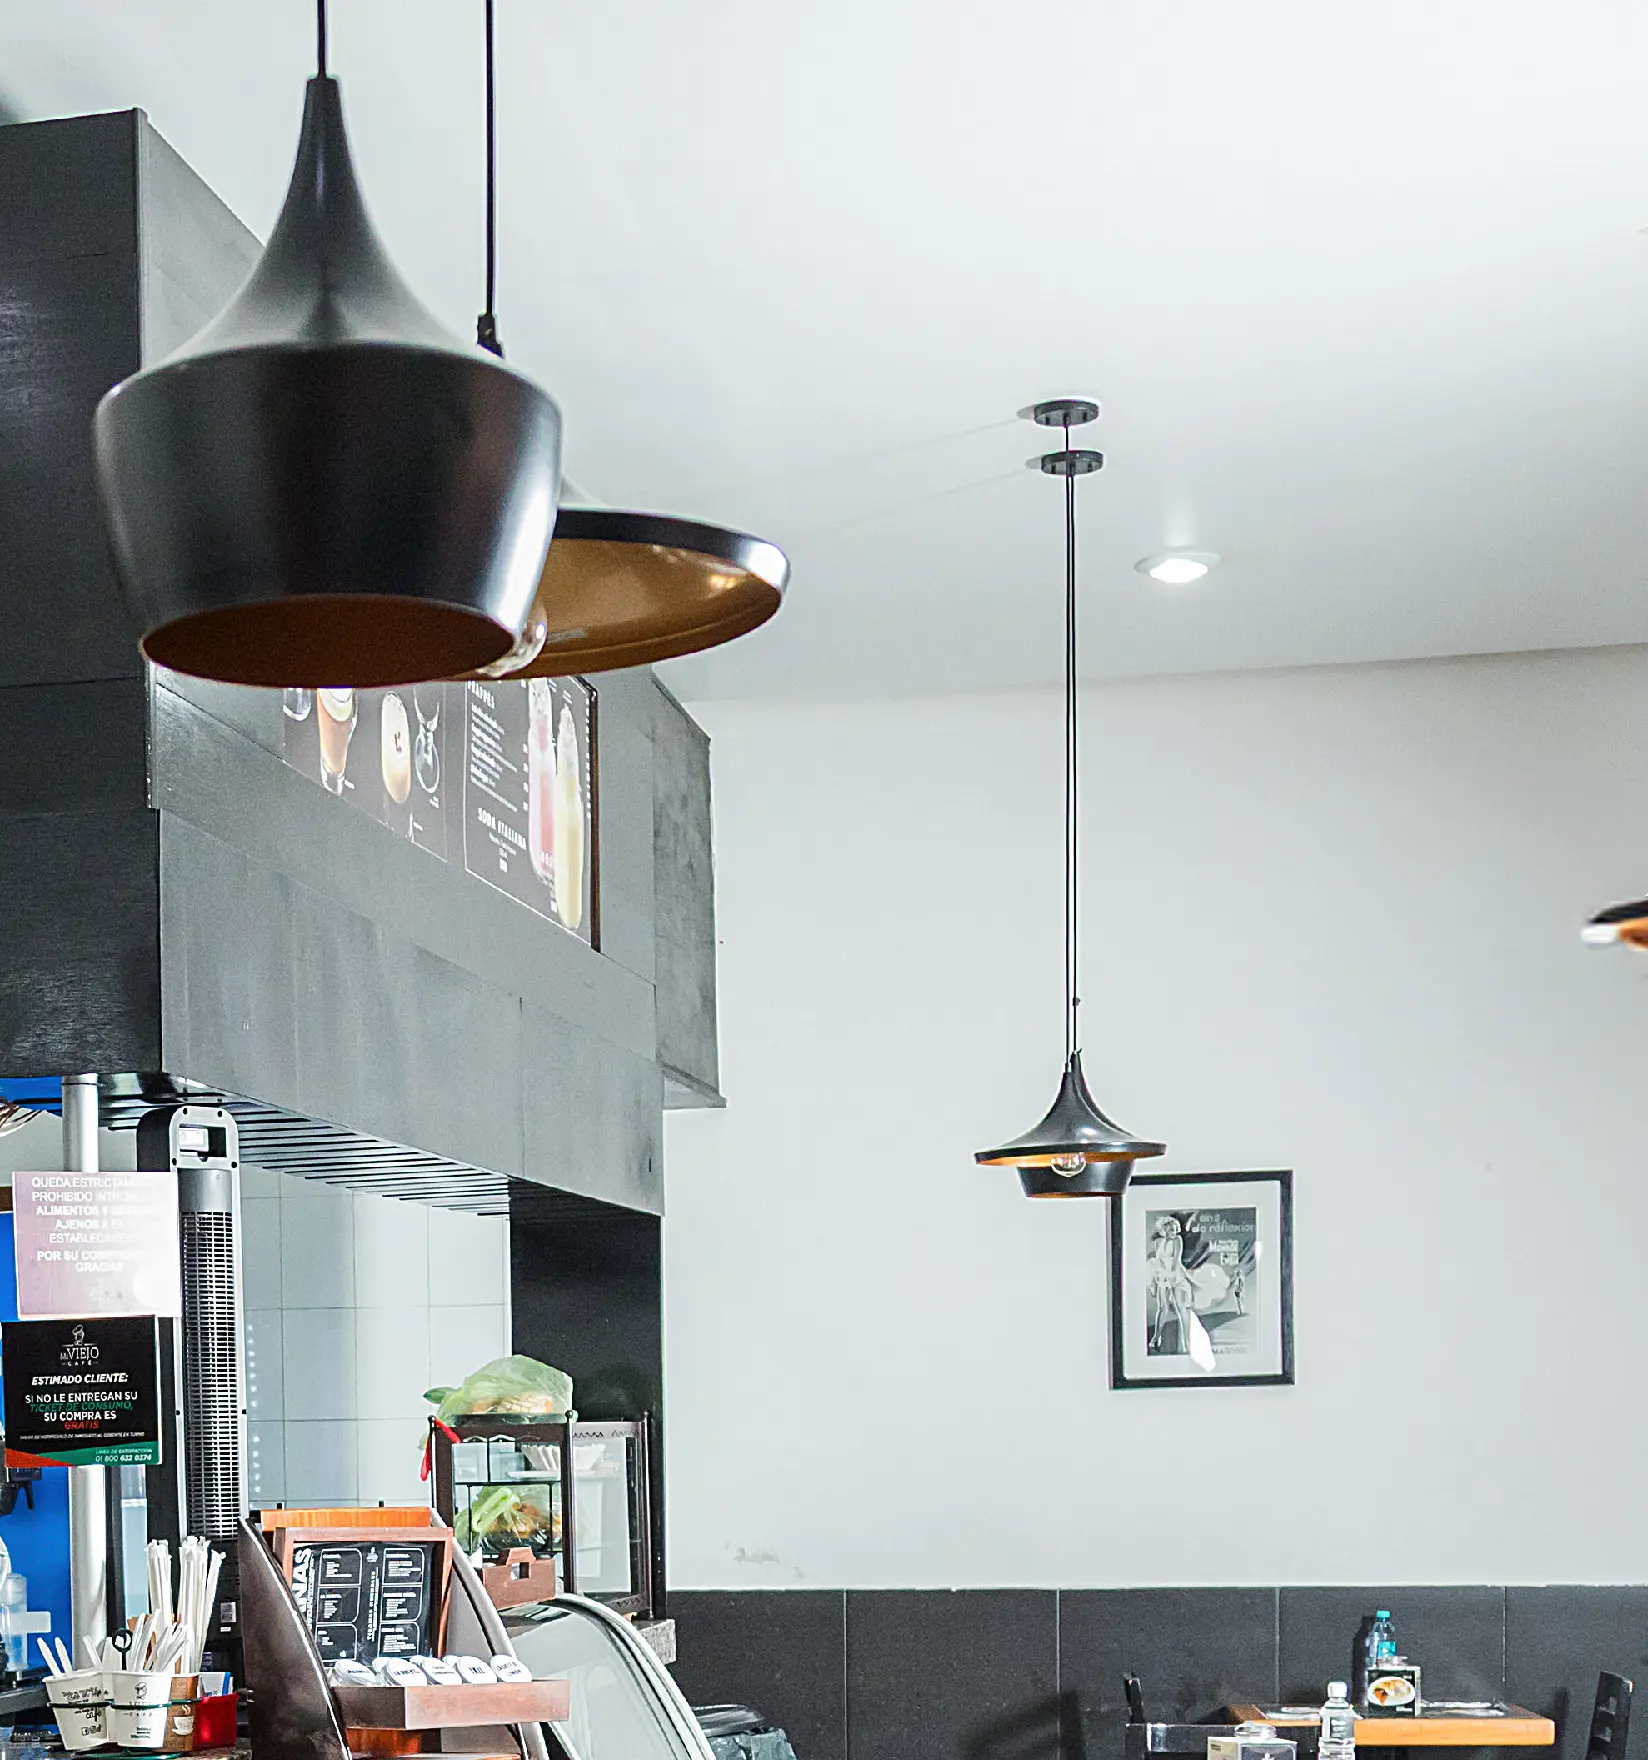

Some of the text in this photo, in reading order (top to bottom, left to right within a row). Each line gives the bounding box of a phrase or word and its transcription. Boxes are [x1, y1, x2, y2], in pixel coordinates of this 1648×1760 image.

[32, 1177, 73, 1188] QUEDA
[32, 1192, 93, 1202] PROHIBIDO
[36, 1205, 100, 1216] ALIMENTOS
[56, 1219, 100, 1230] AJENOS
[37, 1250, 62, 1262] POR
[63, 1250, 79, 1262] SU
[67, 1346, 100, 1360] VIEJO
[31, 1372, 129, 1386] ESTIMADO CLIENTE:
[25, 1391, 138, 1403] SI NO LE ENTREGAN SU
[30, 1403, 62, 1413] TICKET
[65, 1403, 79, 1411] DE
[43, 1410, 117, 1422] SU COMPRA ES
[64, 1421, 99, 1430] GRATIS
